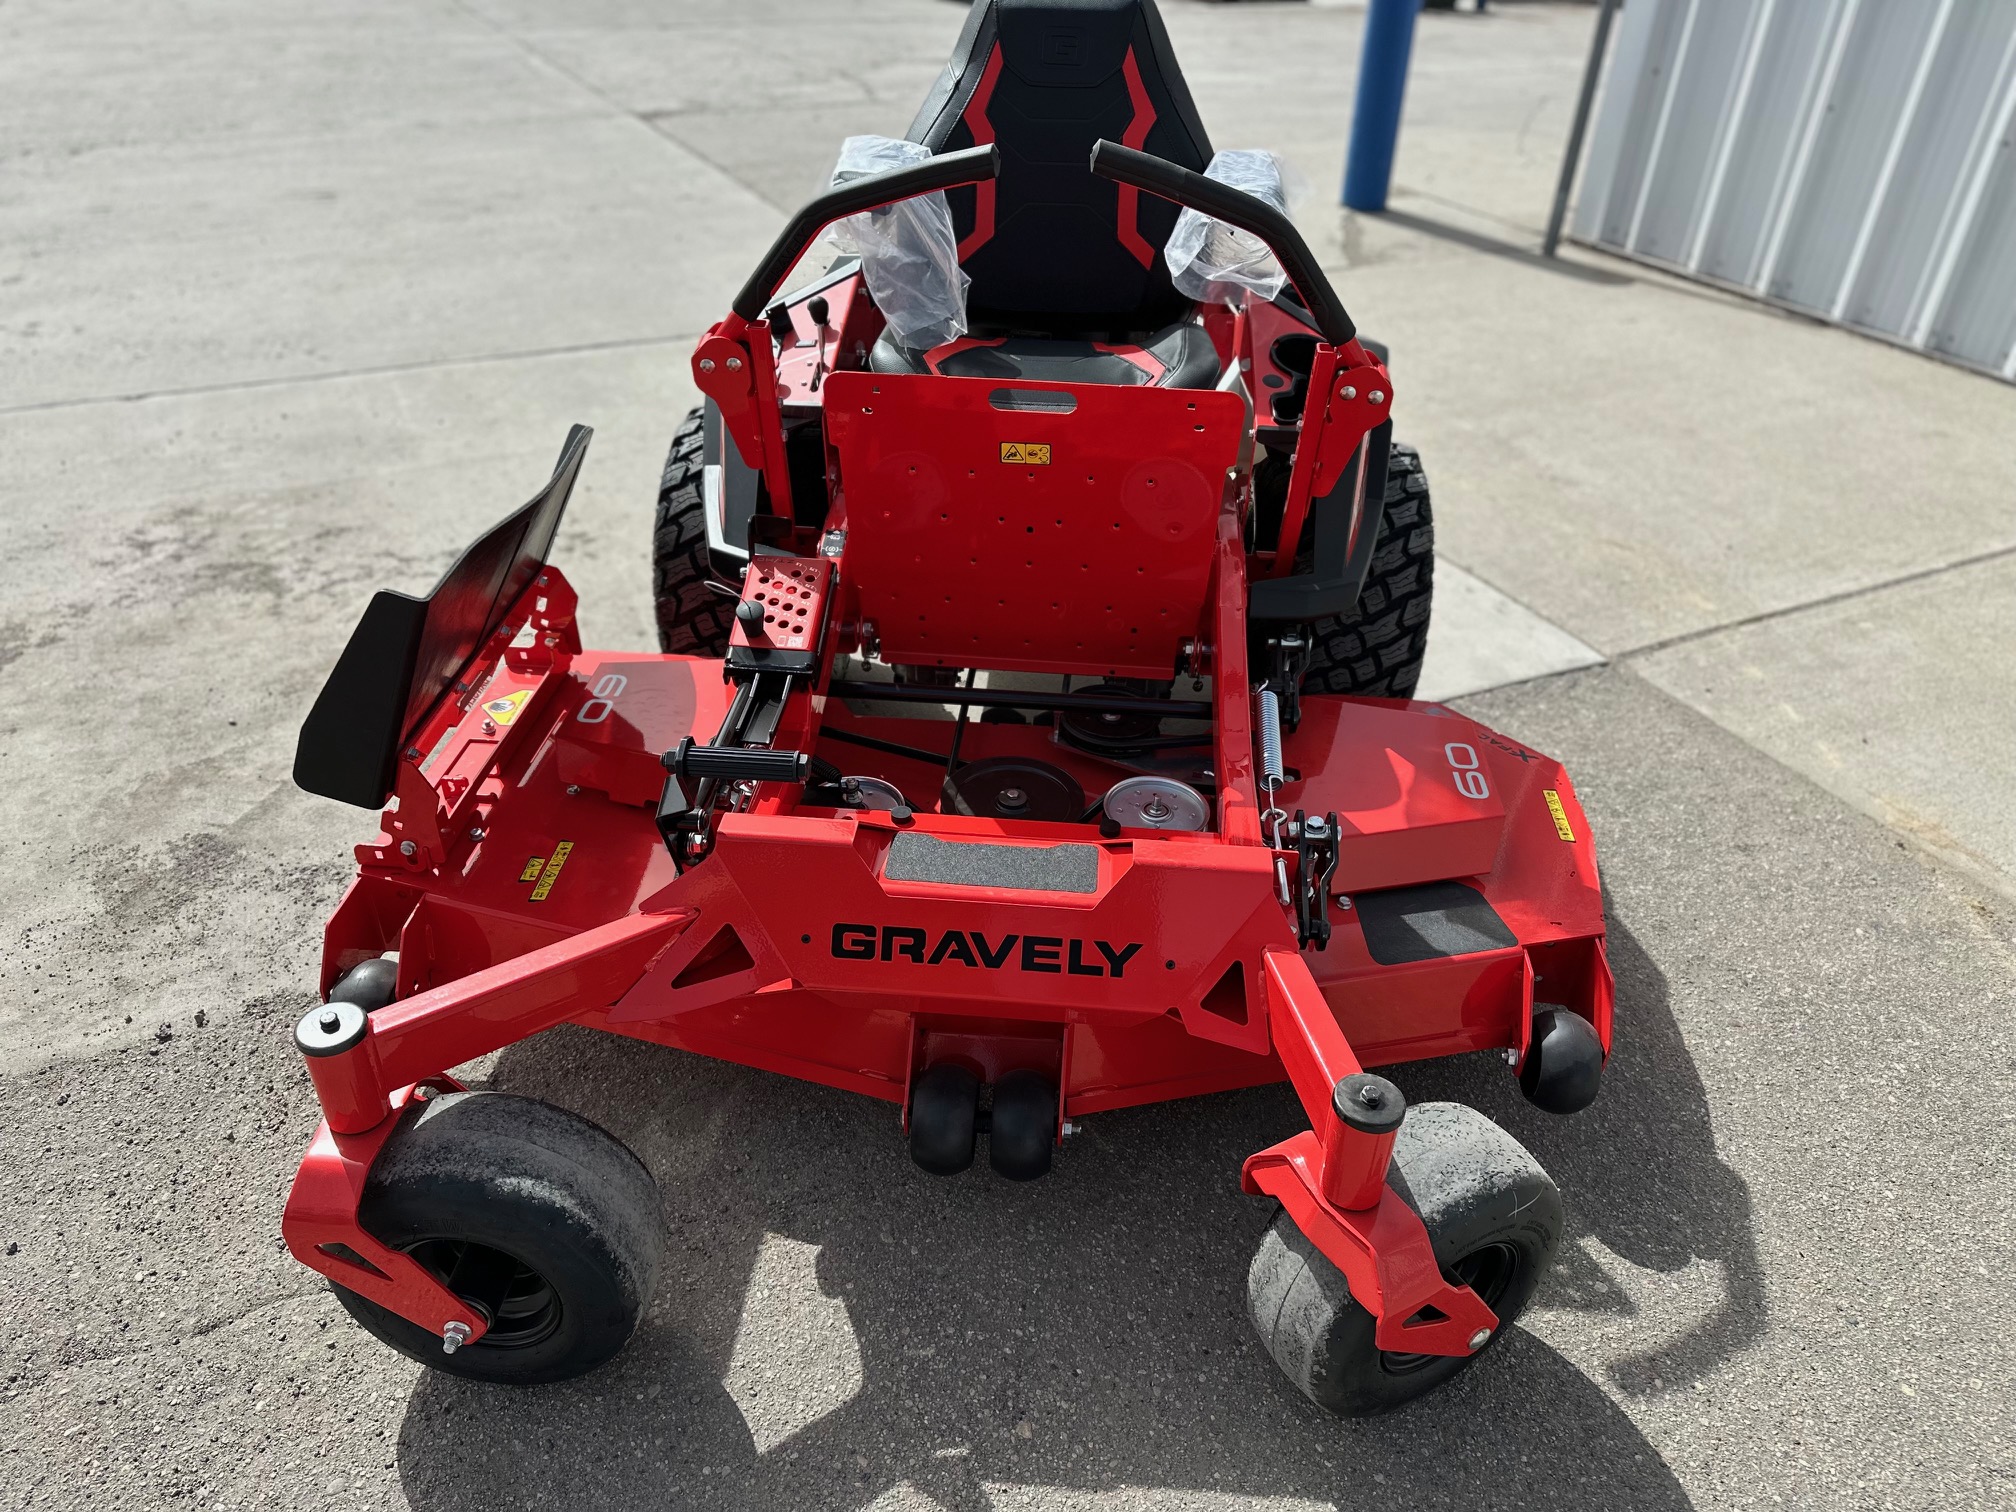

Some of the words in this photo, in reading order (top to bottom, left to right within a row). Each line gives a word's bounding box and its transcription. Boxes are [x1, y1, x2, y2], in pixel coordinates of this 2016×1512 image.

[576, 674, 628, 723] 60
[1444, 742, 1490, 799] 60
[830, 922, 1144, 978] GRAVELY
